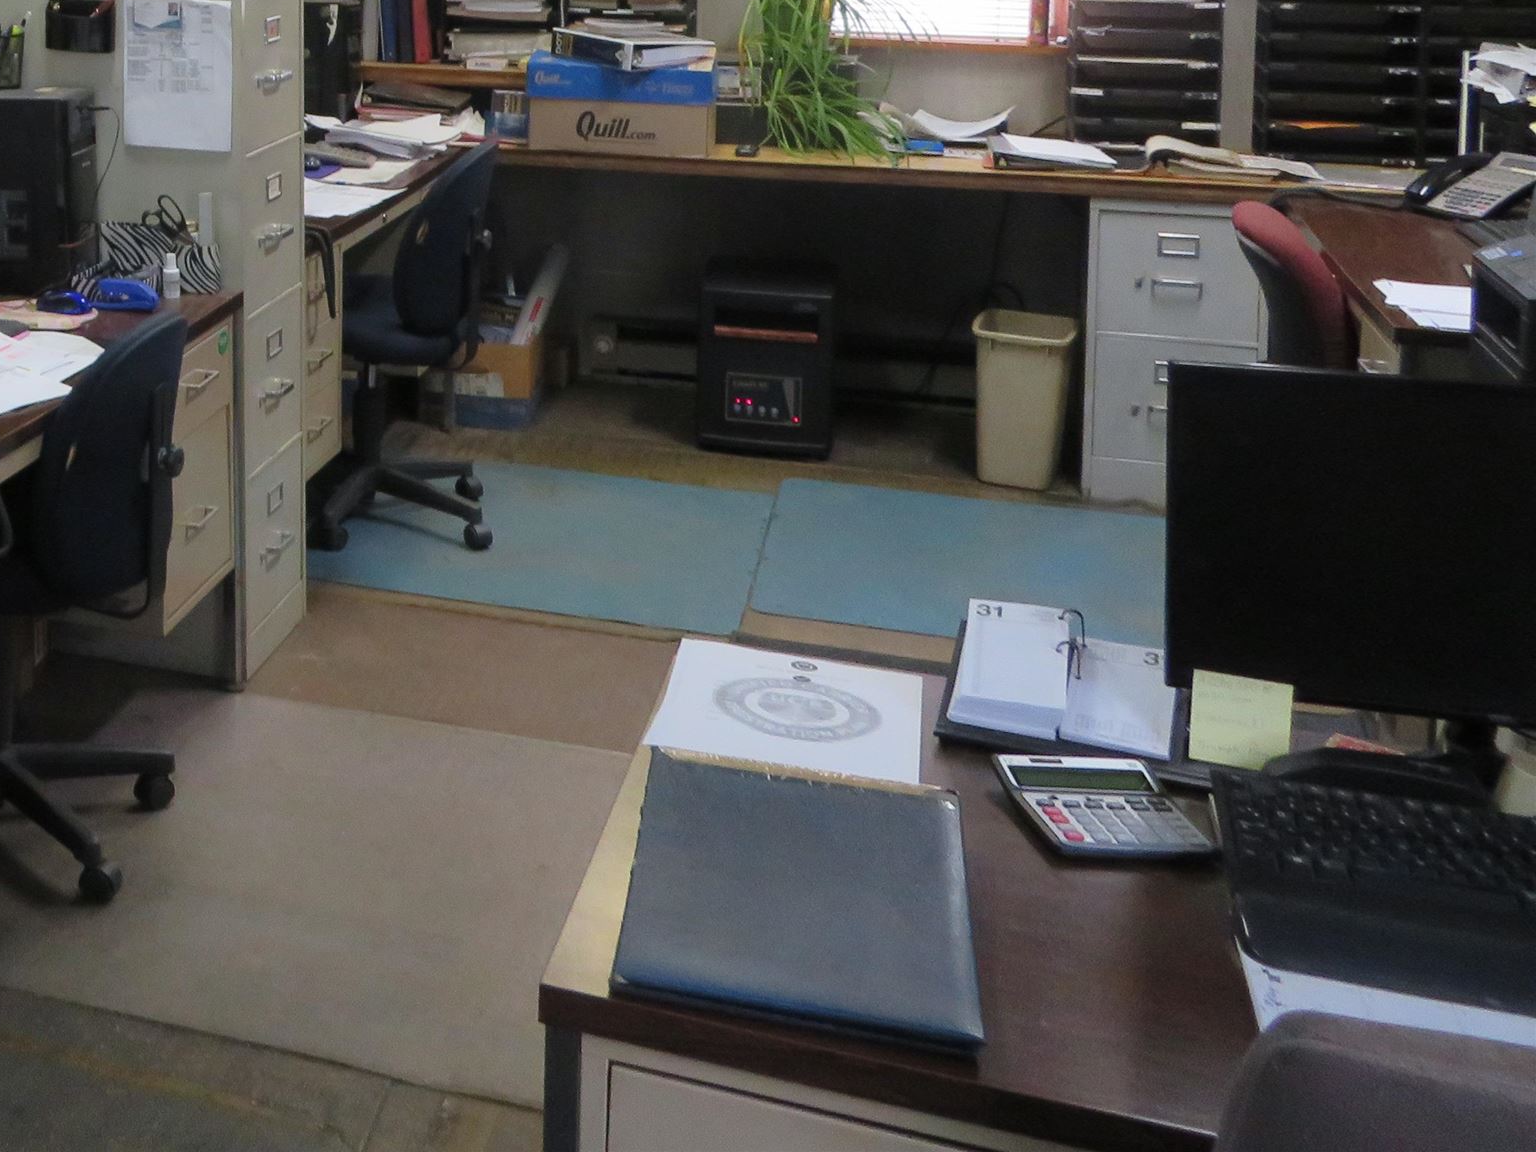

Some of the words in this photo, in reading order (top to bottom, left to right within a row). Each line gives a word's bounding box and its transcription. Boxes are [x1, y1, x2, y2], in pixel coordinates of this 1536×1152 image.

[576, 110, 656, 141] Quill.com
[976, 604, 1004, 618] 31
[1143, 651, 1164, 666] 3
